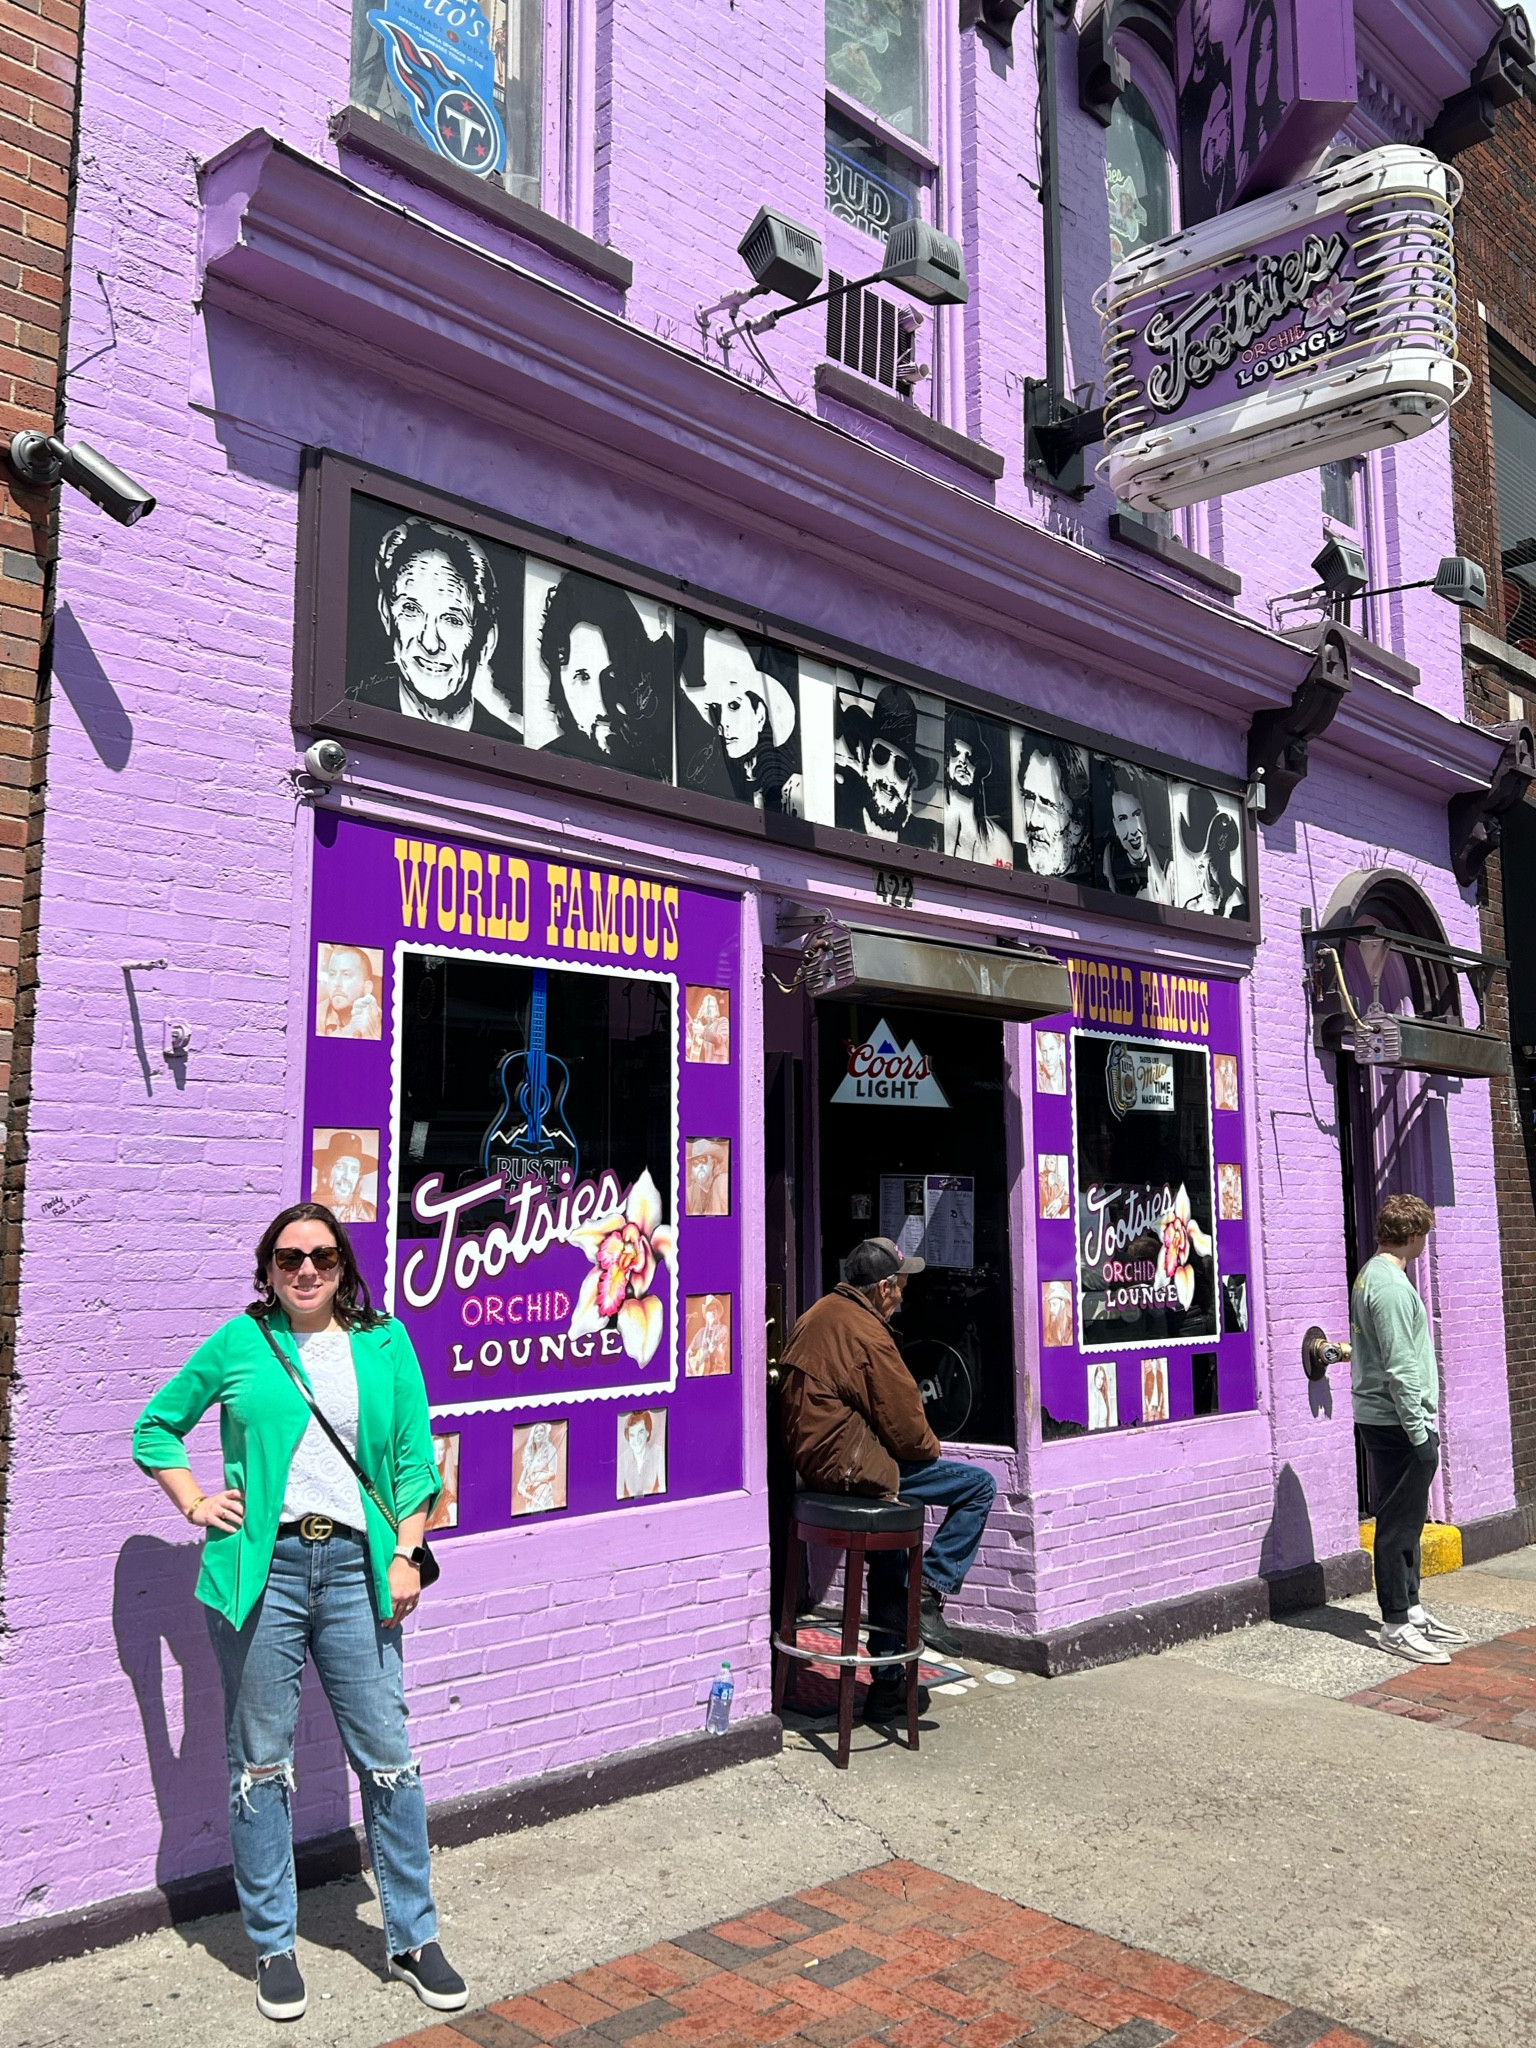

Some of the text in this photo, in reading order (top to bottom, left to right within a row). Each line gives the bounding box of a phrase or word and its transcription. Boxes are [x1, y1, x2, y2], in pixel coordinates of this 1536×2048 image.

[398, 15, 422, 33] OFFICIAL
[422, 28, 443, 44] VODKA
[442, 40, 466, 58] SPONSOR
[474, 60, 484, 70] THE
[418, 33, 466, 65] TENNESSEE TITANS
[1239, 327, 1346, 387] LOUNGE
[1241, 324, 1307, 364] ORCHID
[394, 838, 679, 961] WORLD FAMOUS
[876, 872, 913, 908] 422
[1067, 957, 1209, 1036] WORLD FAMOUS
[847, 1043, 930, 1080] Coors
[1136, 1064, 1169, 1091] Miller
[856, 1080, 917, 1099] LIGHT
[1142, 1095, 1169, 1105] NASHVILLE
[1154, 1081, 1173, 1096] TIME,
[496, 1157, 569, 1185] BUSCH
[403, 1172, 628, 1307] Tootsies
[1085, 1185, 1175, 1266] Tootsies
[1103, 1260, 1155, 1282] ORCHID
[462, 1290, 571, 1327] ORCHID
[1106, 1284, 1178, 1307] LOUNGE
[452, 1328, 623, 1372] LOUNGE
